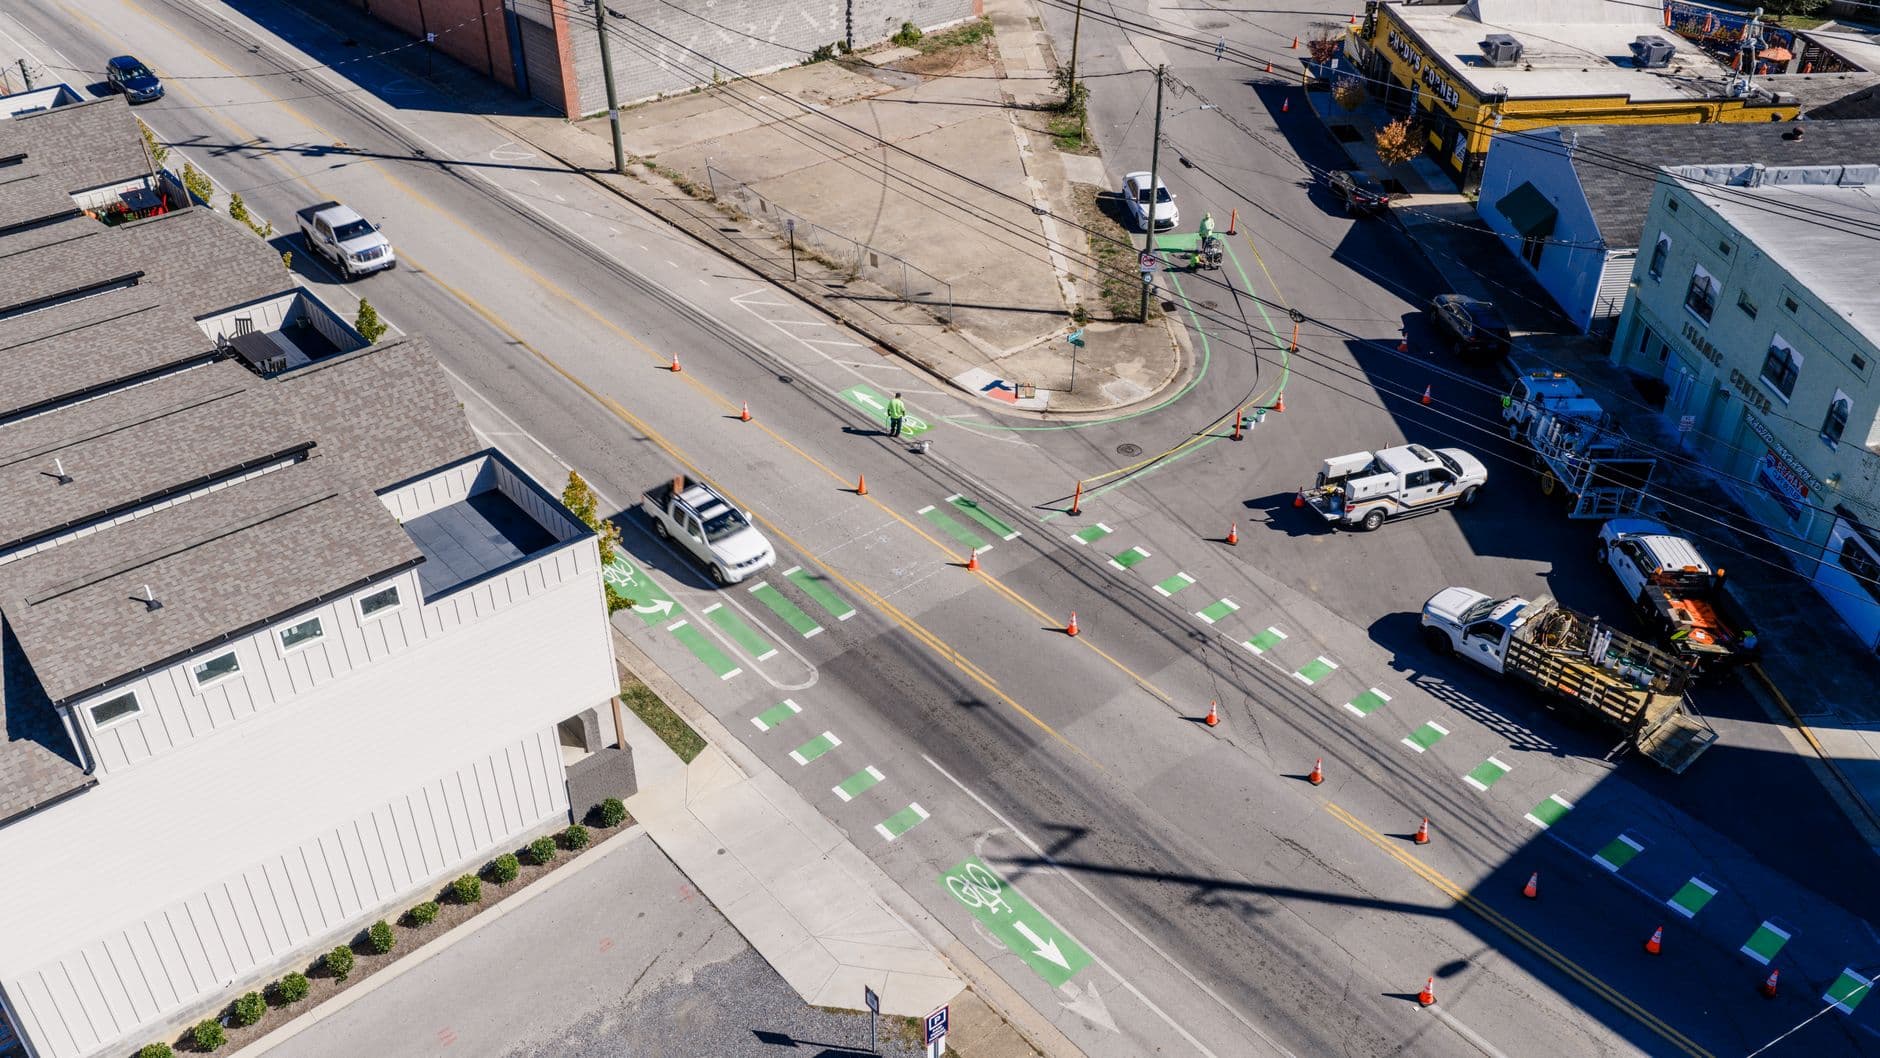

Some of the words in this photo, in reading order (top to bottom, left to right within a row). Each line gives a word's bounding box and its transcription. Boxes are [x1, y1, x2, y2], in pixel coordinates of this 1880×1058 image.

[1389, 31, 1421, 70] SHADY'S
[1423, 64, 1459, 107] CORNER
[1681, 320, 1724, 368] ISLAMIC
[1730, 367, 1772, 416] CENTER
